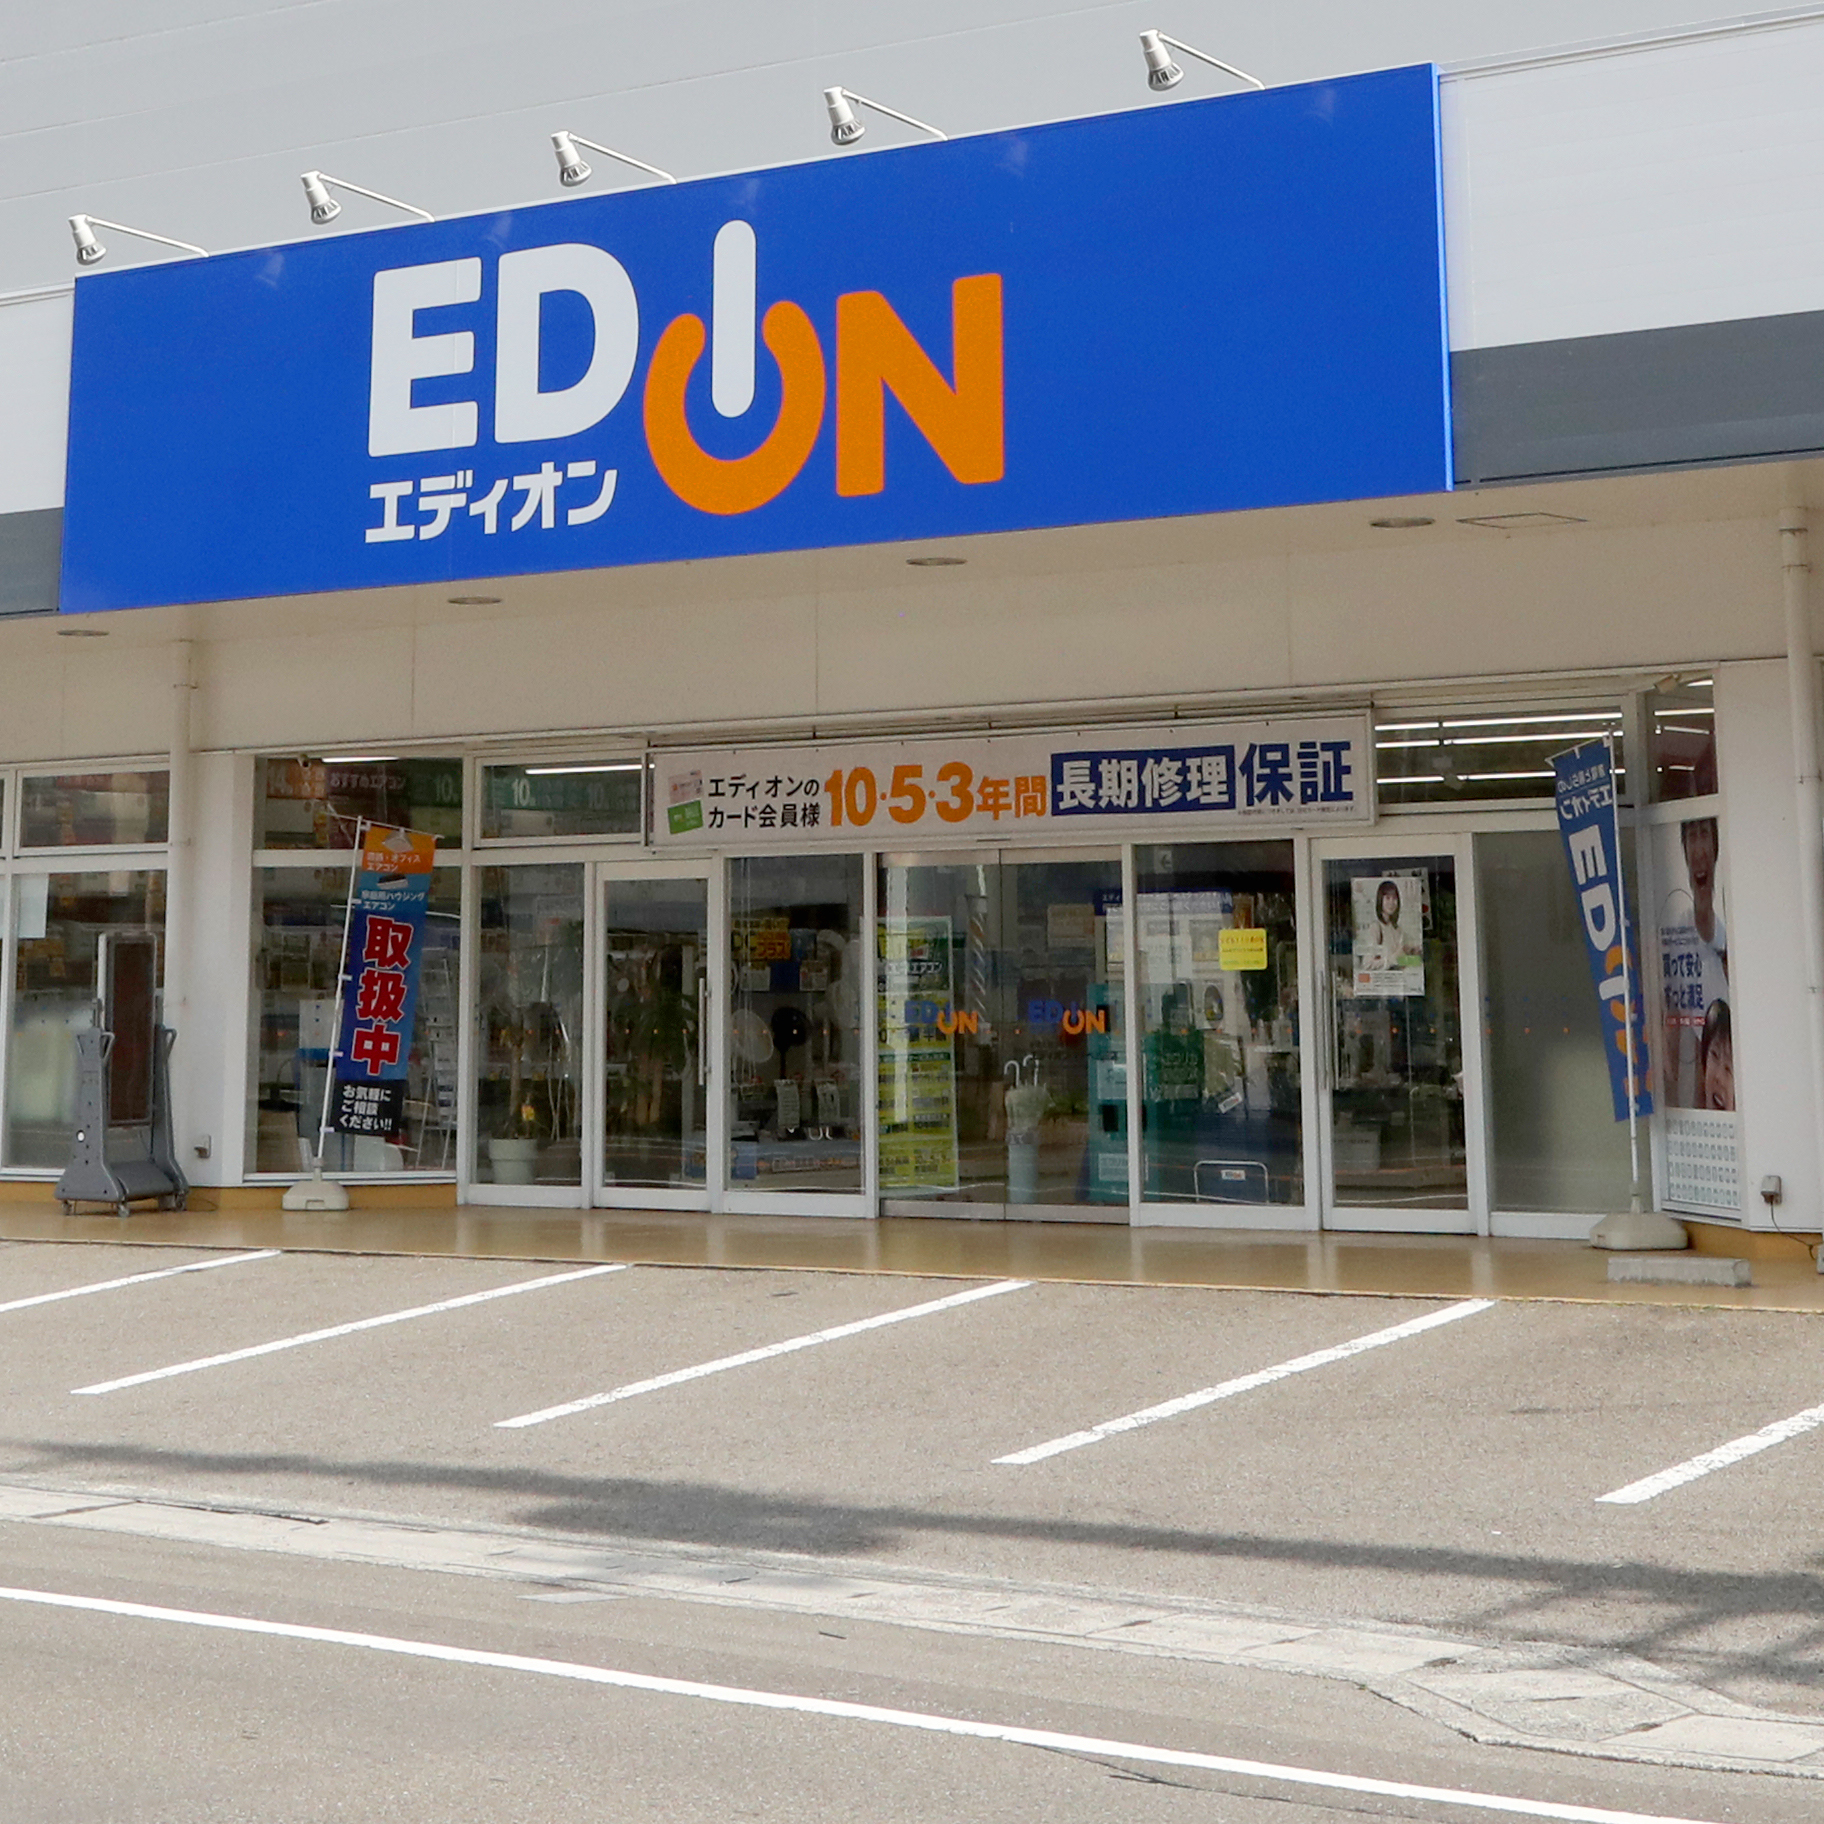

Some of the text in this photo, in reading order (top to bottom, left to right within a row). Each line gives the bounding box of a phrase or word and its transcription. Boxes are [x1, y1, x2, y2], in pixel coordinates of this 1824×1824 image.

[367, 219, 1003, 515] EDION
[365, 460, 620, 545] エディオン
[708, 772, 820, 800] エディオンの
[708, 802, 822, 829] カード会員様
[362, 901, 396, 911] エアコン
[350, 914, 414, 1076] 取扱中
[1027, 999, 1106, 1035] EDION
